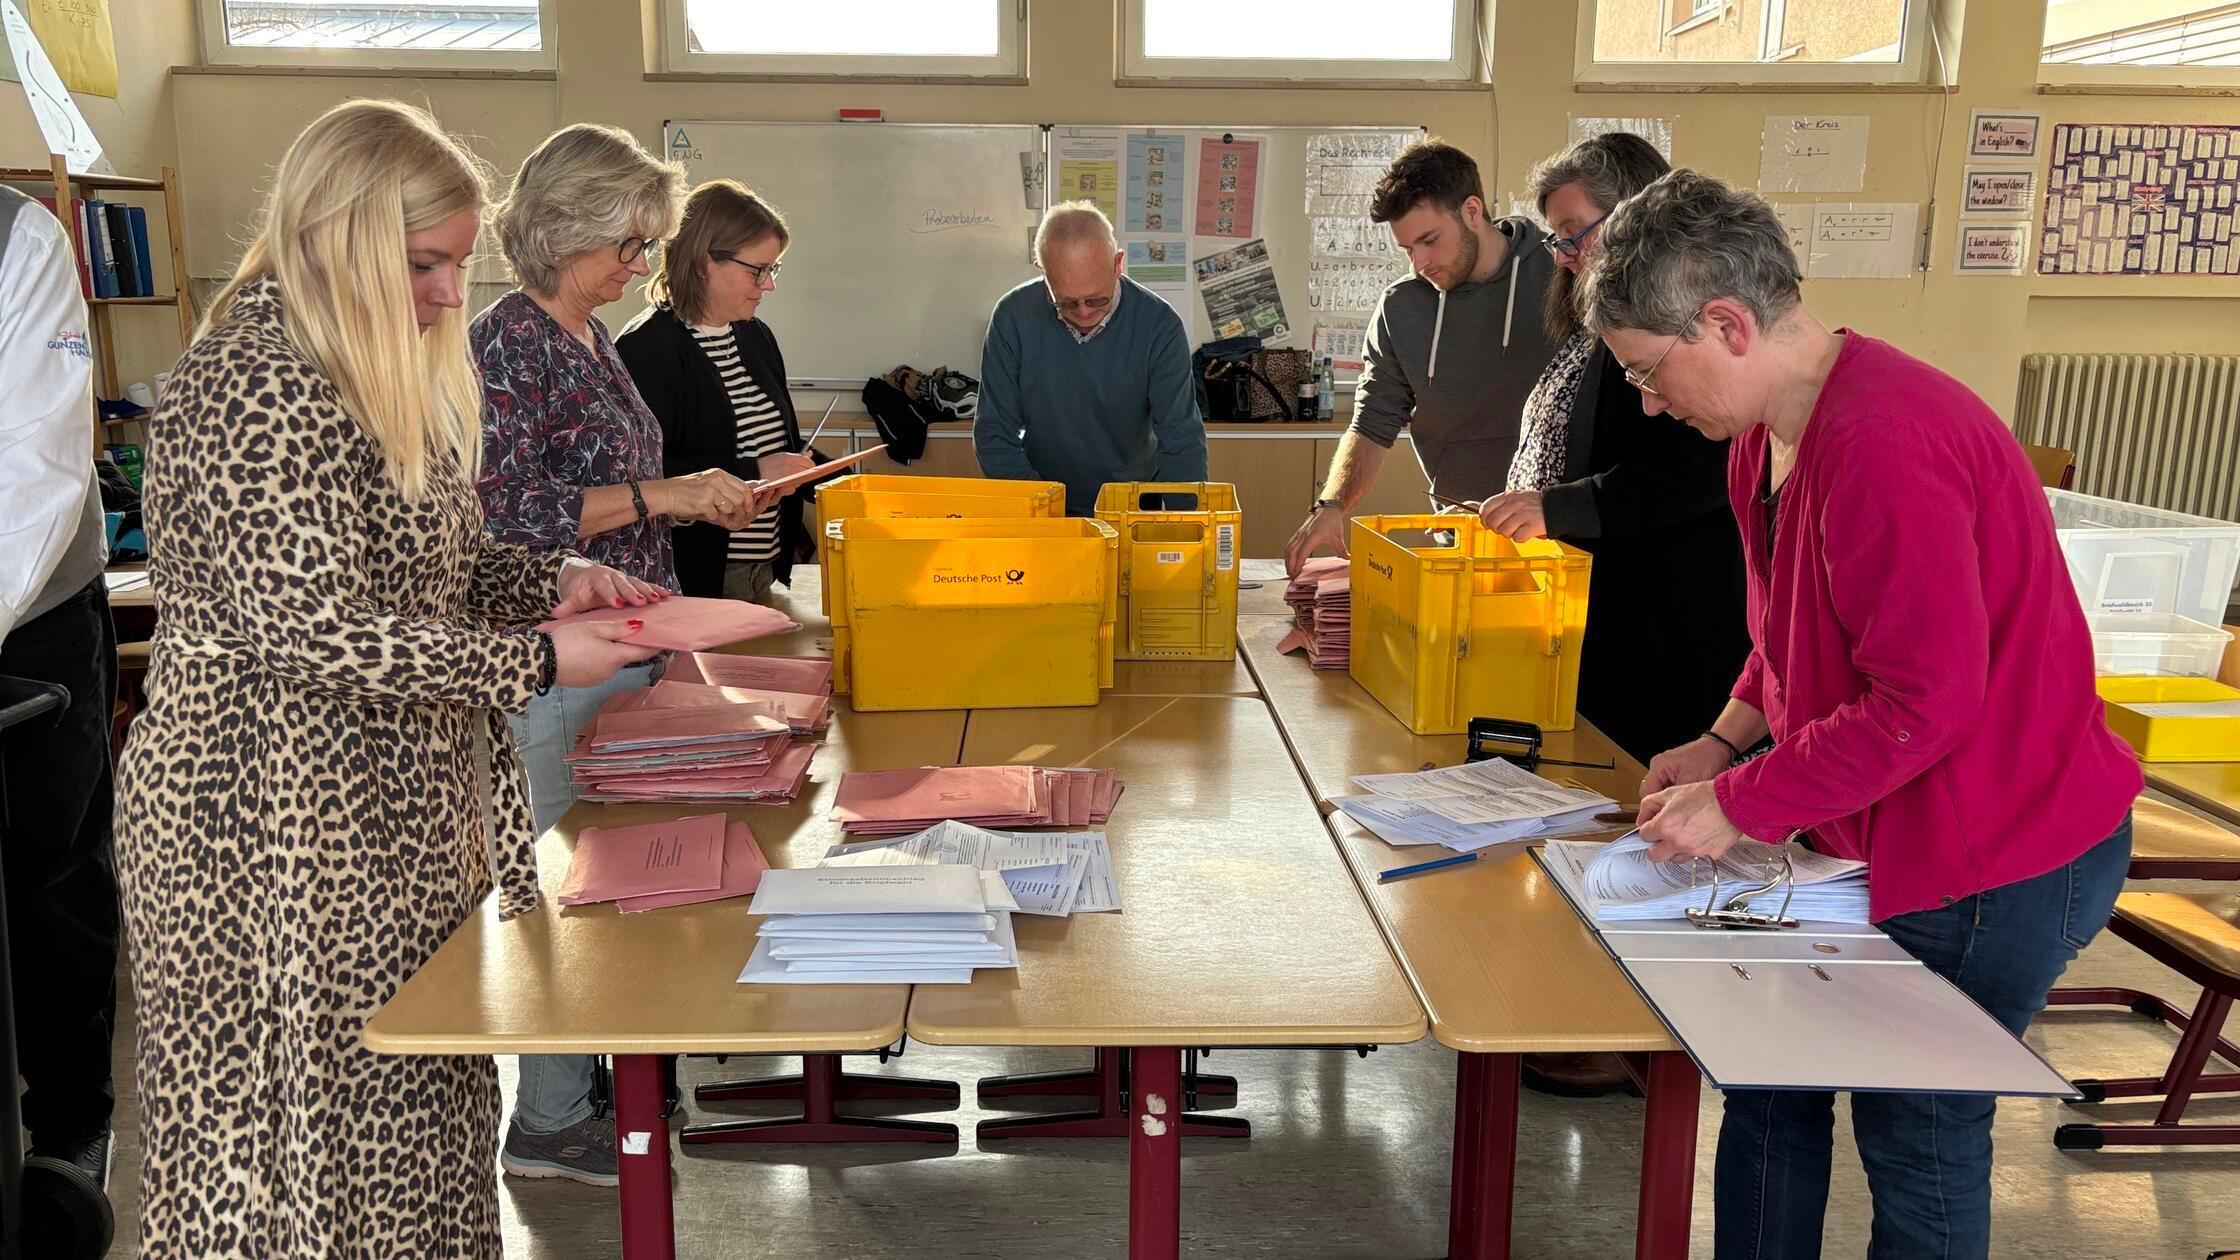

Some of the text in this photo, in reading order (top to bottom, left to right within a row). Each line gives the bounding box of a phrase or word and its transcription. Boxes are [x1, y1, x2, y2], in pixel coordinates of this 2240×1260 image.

[1795, 120, 1812, 130] Der
[1982, 121, 2004, 132] What's
[1987, 135, 2015, 150] English?
[1320, 148, 1339, 158] Das
[1972, 179, 1985, 193] May
[1987, 178, 1993, 190] I
[1971, 194, 2008, 206] the window?
[1327, 240, 1337, 251] A
[1379, 240, 1387, 251] b
[1968, 236, 1973, 247] I
[1974, 236, 1987, 247] don't
[1967, 249, 1976, 260] the
[1311, 262, 1319, 272] U
[1333, 263, 1340, 271] a
[1350, 262, 1358, 271] b
[1310, 295, 1321, 308] U
[933, 574, 1001, 583] Deutsche Post
